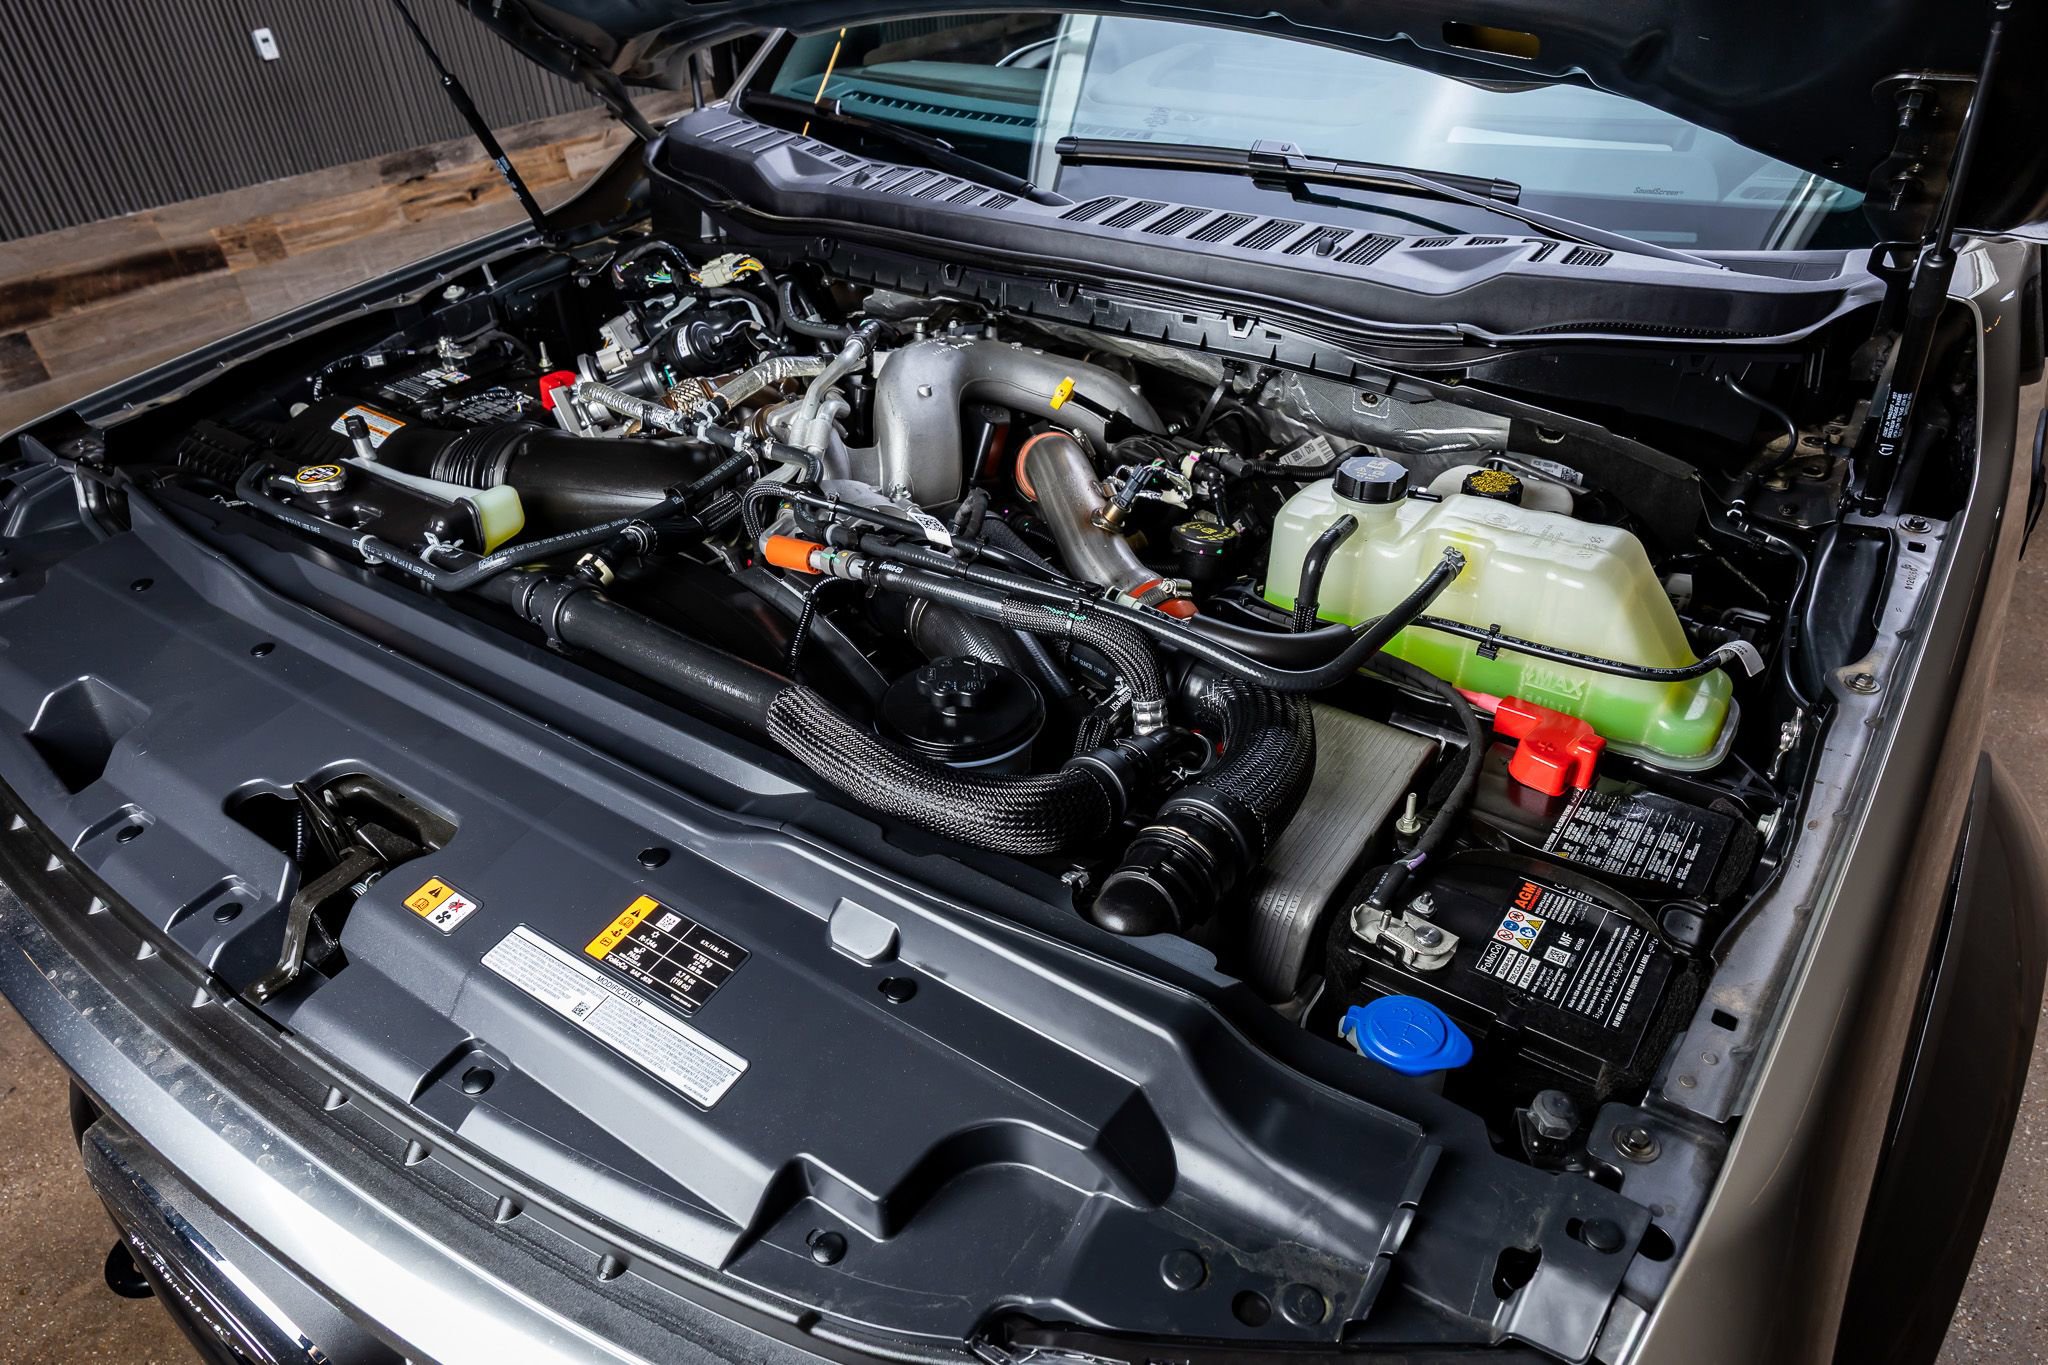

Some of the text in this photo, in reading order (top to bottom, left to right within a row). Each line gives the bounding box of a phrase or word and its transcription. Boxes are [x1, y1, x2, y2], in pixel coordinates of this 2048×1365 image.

[1533, 668, 1586, 697] MAX
[1513, 881, 1537, 908] AGM
[1557, 930, 1574, 947] MF
[604, 953, 629, 970] FoMoCo
[1480, 942, 1502, 971] FoMoCo
[594, 974, 644, 1006] MODIFICATION
